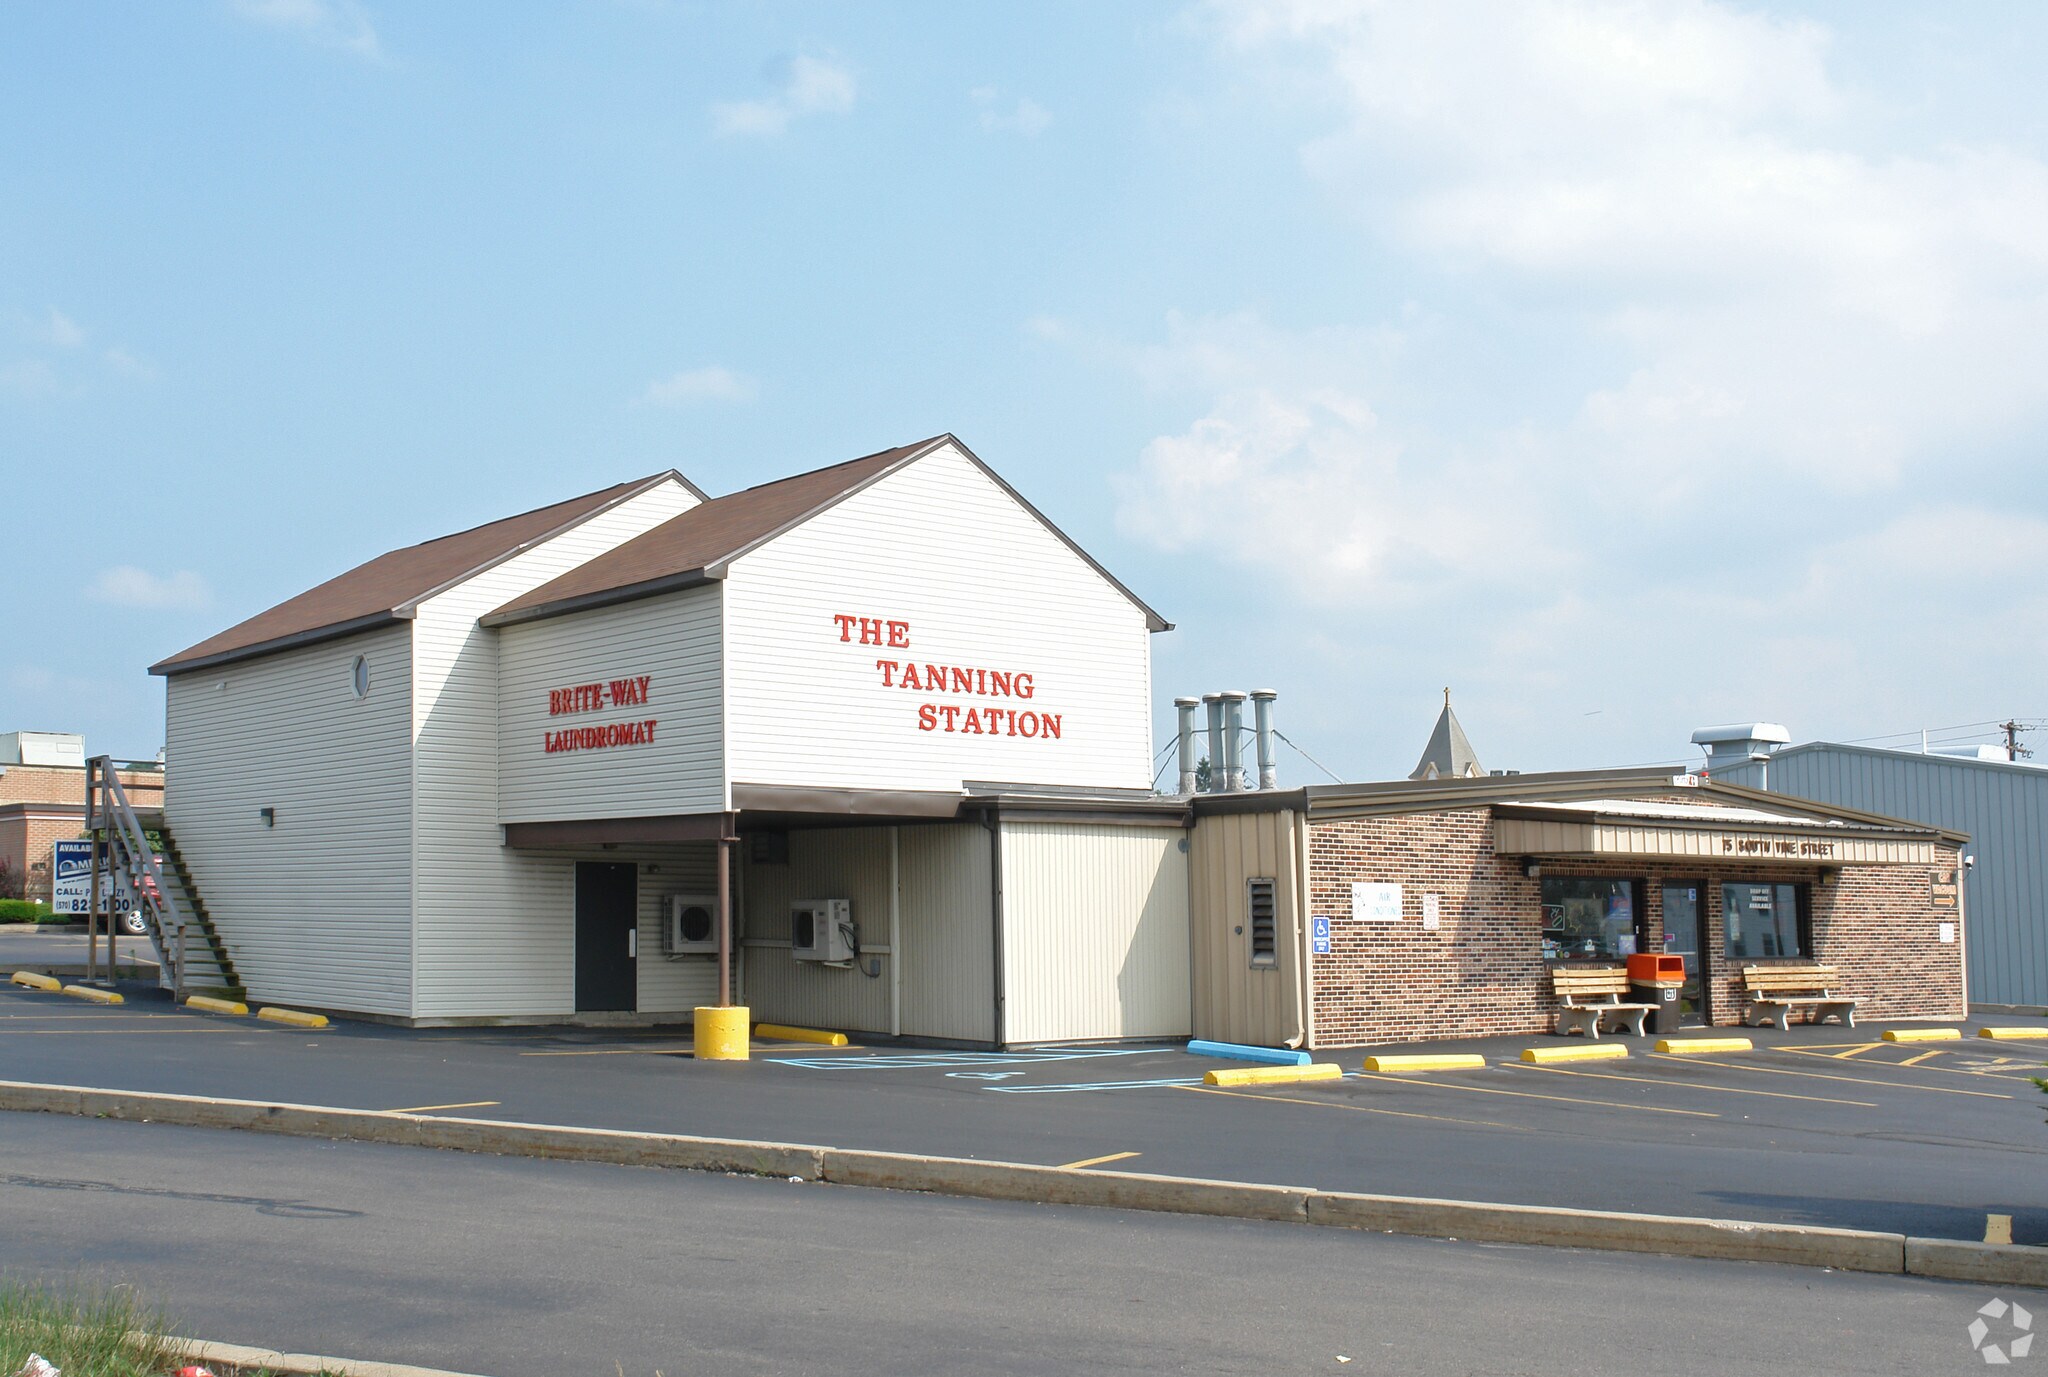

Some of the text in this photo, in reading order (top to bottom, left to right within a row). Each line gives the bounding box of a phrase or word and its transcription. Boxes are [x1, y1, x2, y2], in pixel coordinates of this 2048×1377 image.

[834, 614, 910, 649] THE
[548, 675, 651, 716] BRITE-WAY
[876, 660, 1035, 699] TANNING
[544, 719, 657, 754] LAUNDROMAT
[918, 704, 1062, 739] STATION
[1738, 840, 1771, 854] SOUTH
[1800, 843, 1835, 856] STREET
[56, 888, 83, 896] CALL:
